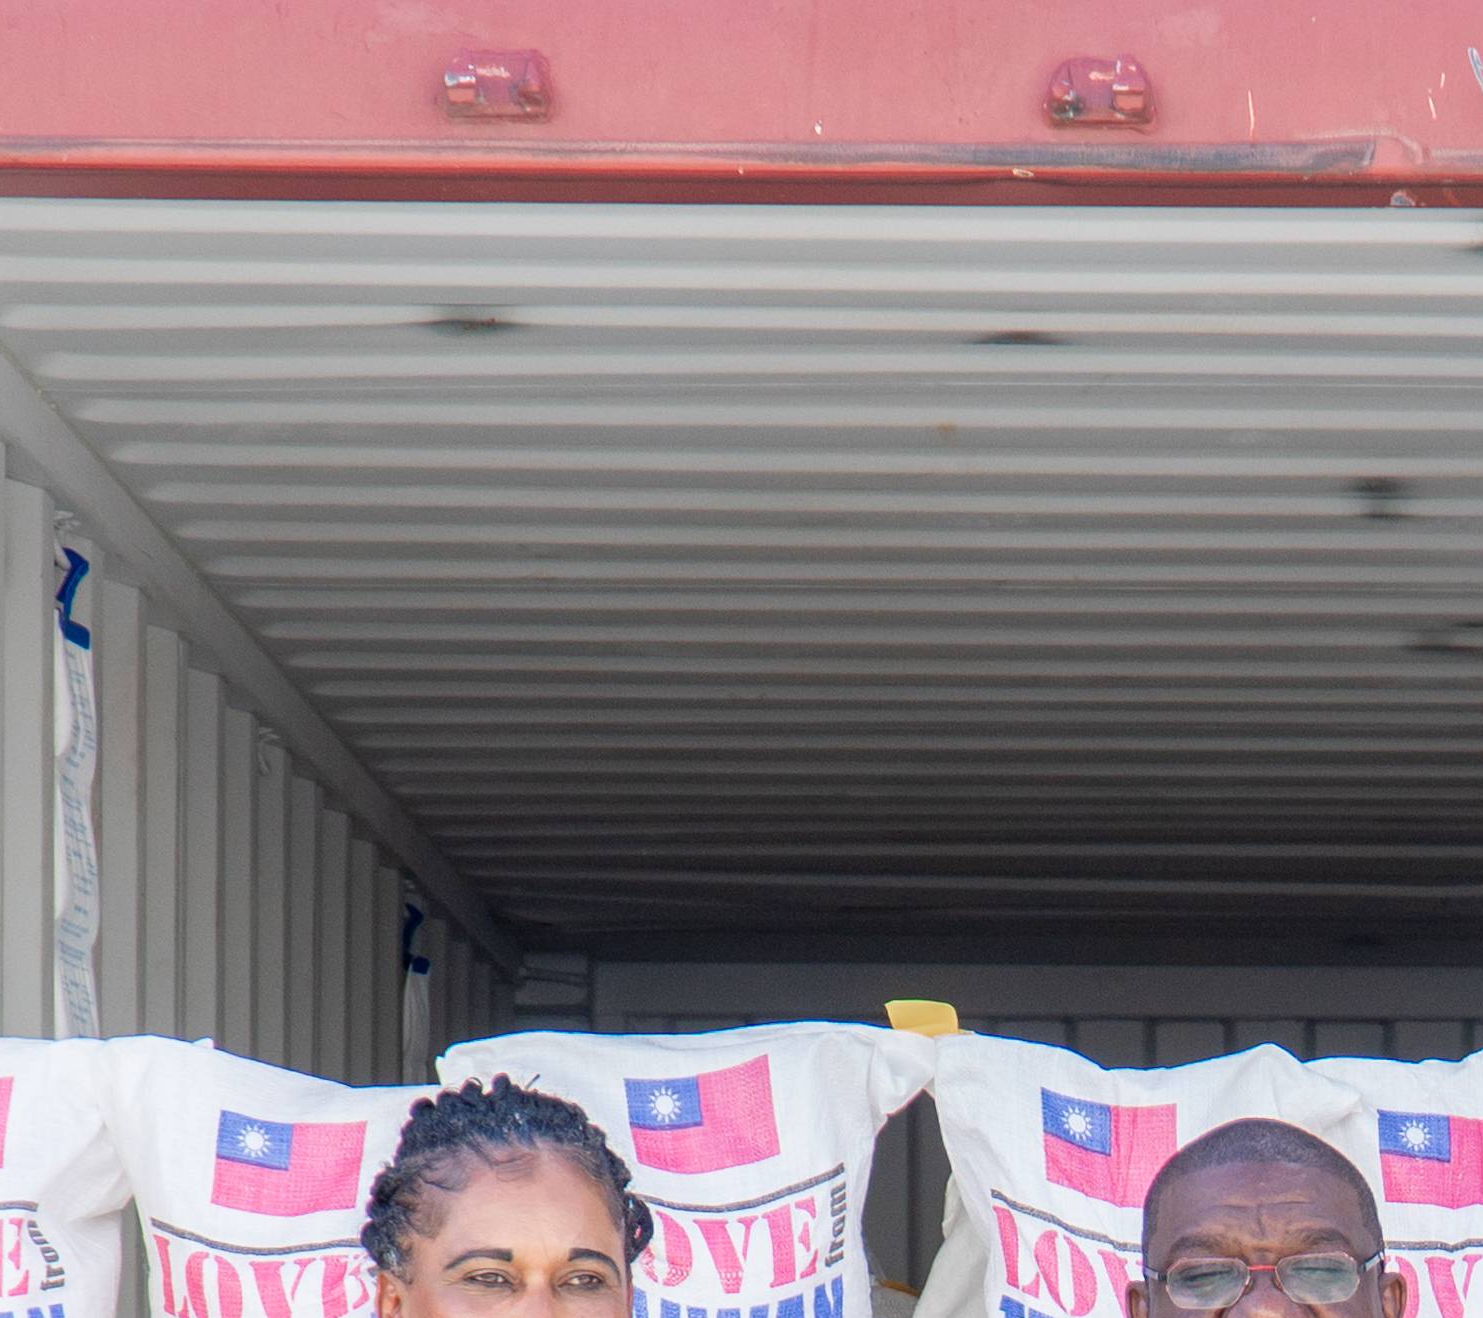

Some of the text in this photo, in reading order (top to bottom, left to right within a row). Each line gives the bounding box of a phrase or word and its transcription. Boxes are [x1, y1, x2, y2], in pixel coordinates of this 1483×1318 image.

[27, 1219, 65, 1291] from
[635, 1195, 819, 1295] OVE
[824, 1181, 848, 1268] from
